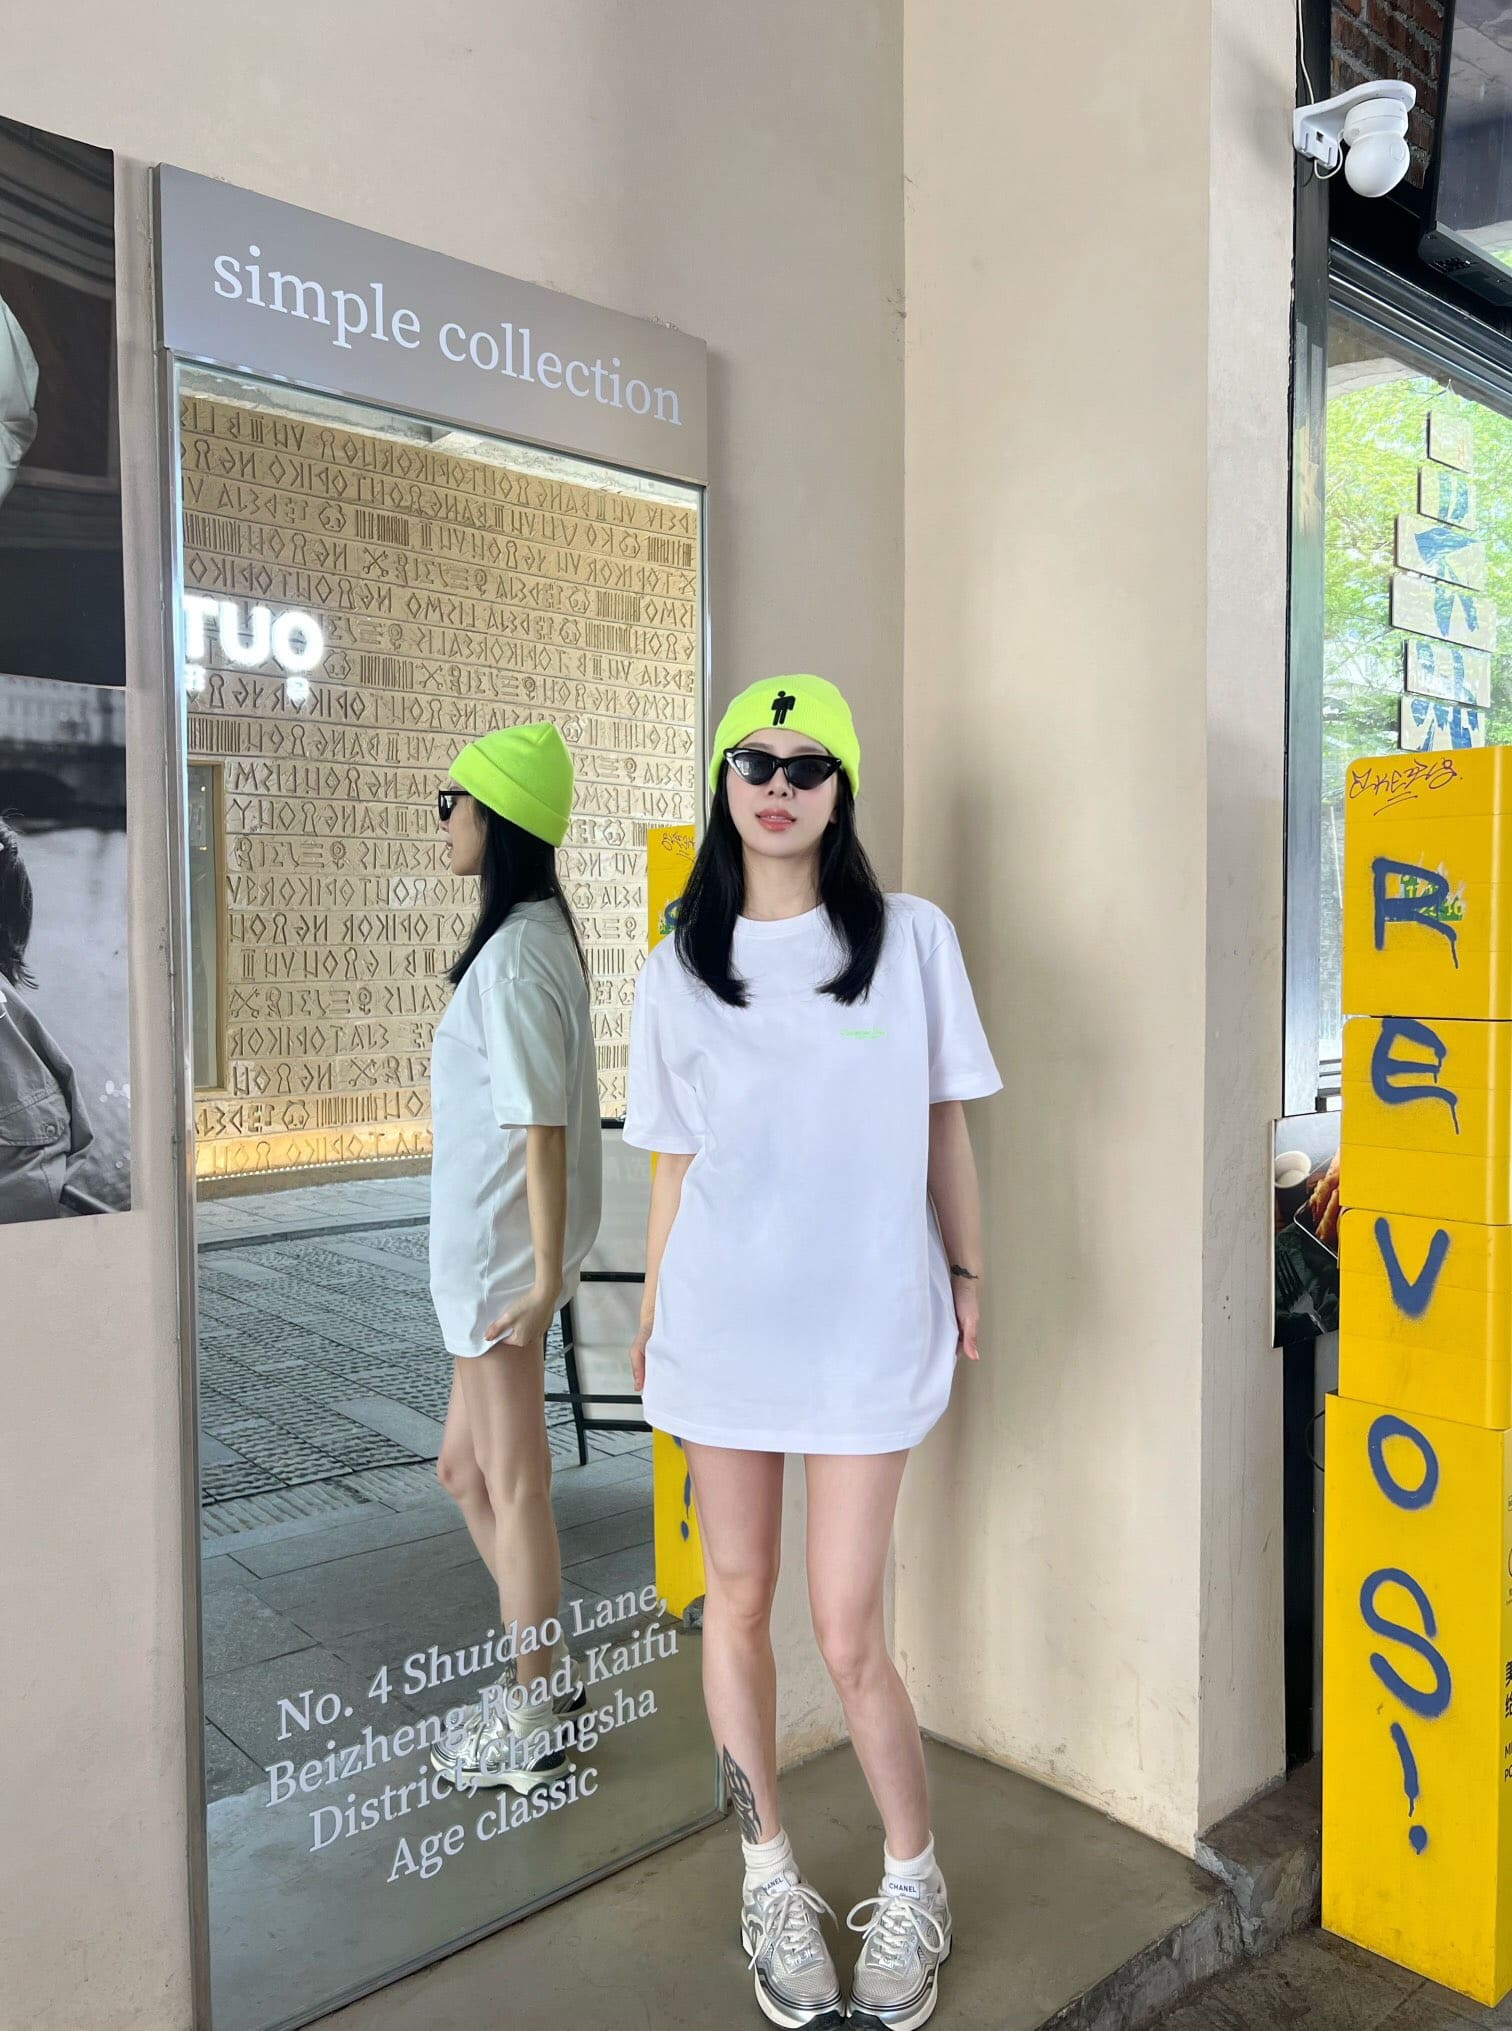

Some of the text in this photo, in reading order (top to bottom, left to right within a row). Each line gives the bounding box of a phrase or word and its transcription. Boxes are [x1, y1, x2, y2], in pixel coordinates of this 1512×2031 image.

[212, 244, 683, 426] simple collection
[276, 1583, 668, 1741] No. 4 Shuidao Lane,
[264, 1704, 468, 1808] Beizheng
[386, 1763, 599, 1884] Age classic
[889, 1882, 917, 1893] CHANEL
